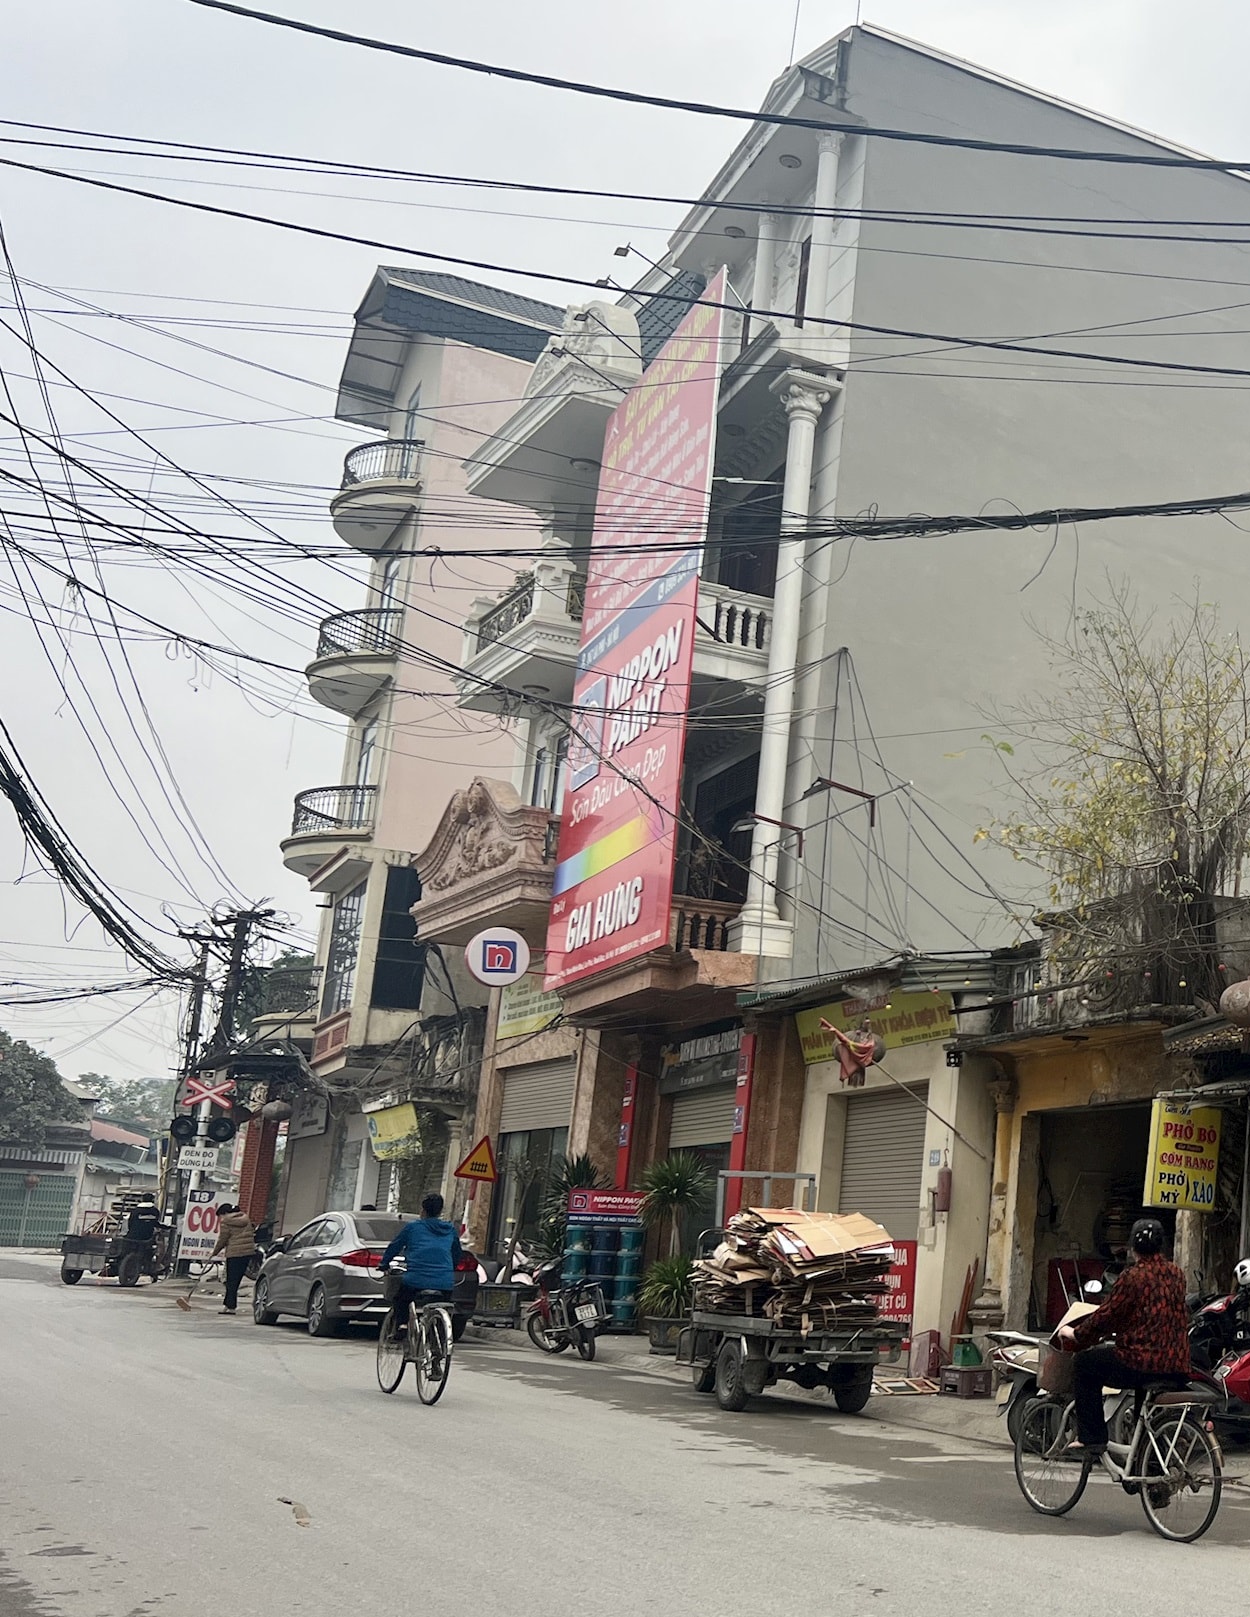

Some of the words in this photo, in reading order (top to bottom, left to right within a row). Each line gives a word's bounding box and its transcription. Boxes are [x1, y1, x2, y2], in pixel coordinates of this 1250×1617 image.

[606, 619, 684, 715] NIPPON
[607, 679, 667, 758] PAINT
[565, 900, 593, 953] GIA
[592, 876, 643, 942] HƯNG
[1163, 1120, 1194, 1140] PHỞ
[1197, 1125, 1217, 1144] BÒ
[1160, 1152, 1183, 1168] CƠM
[1184, 1156, 1215, 1172] RANG
[1159, 1170, 1185, 1186] PHỞ
[1192, 1176, 1213, 1204] XÀO
[194, 1191, 210, 1202] 18
